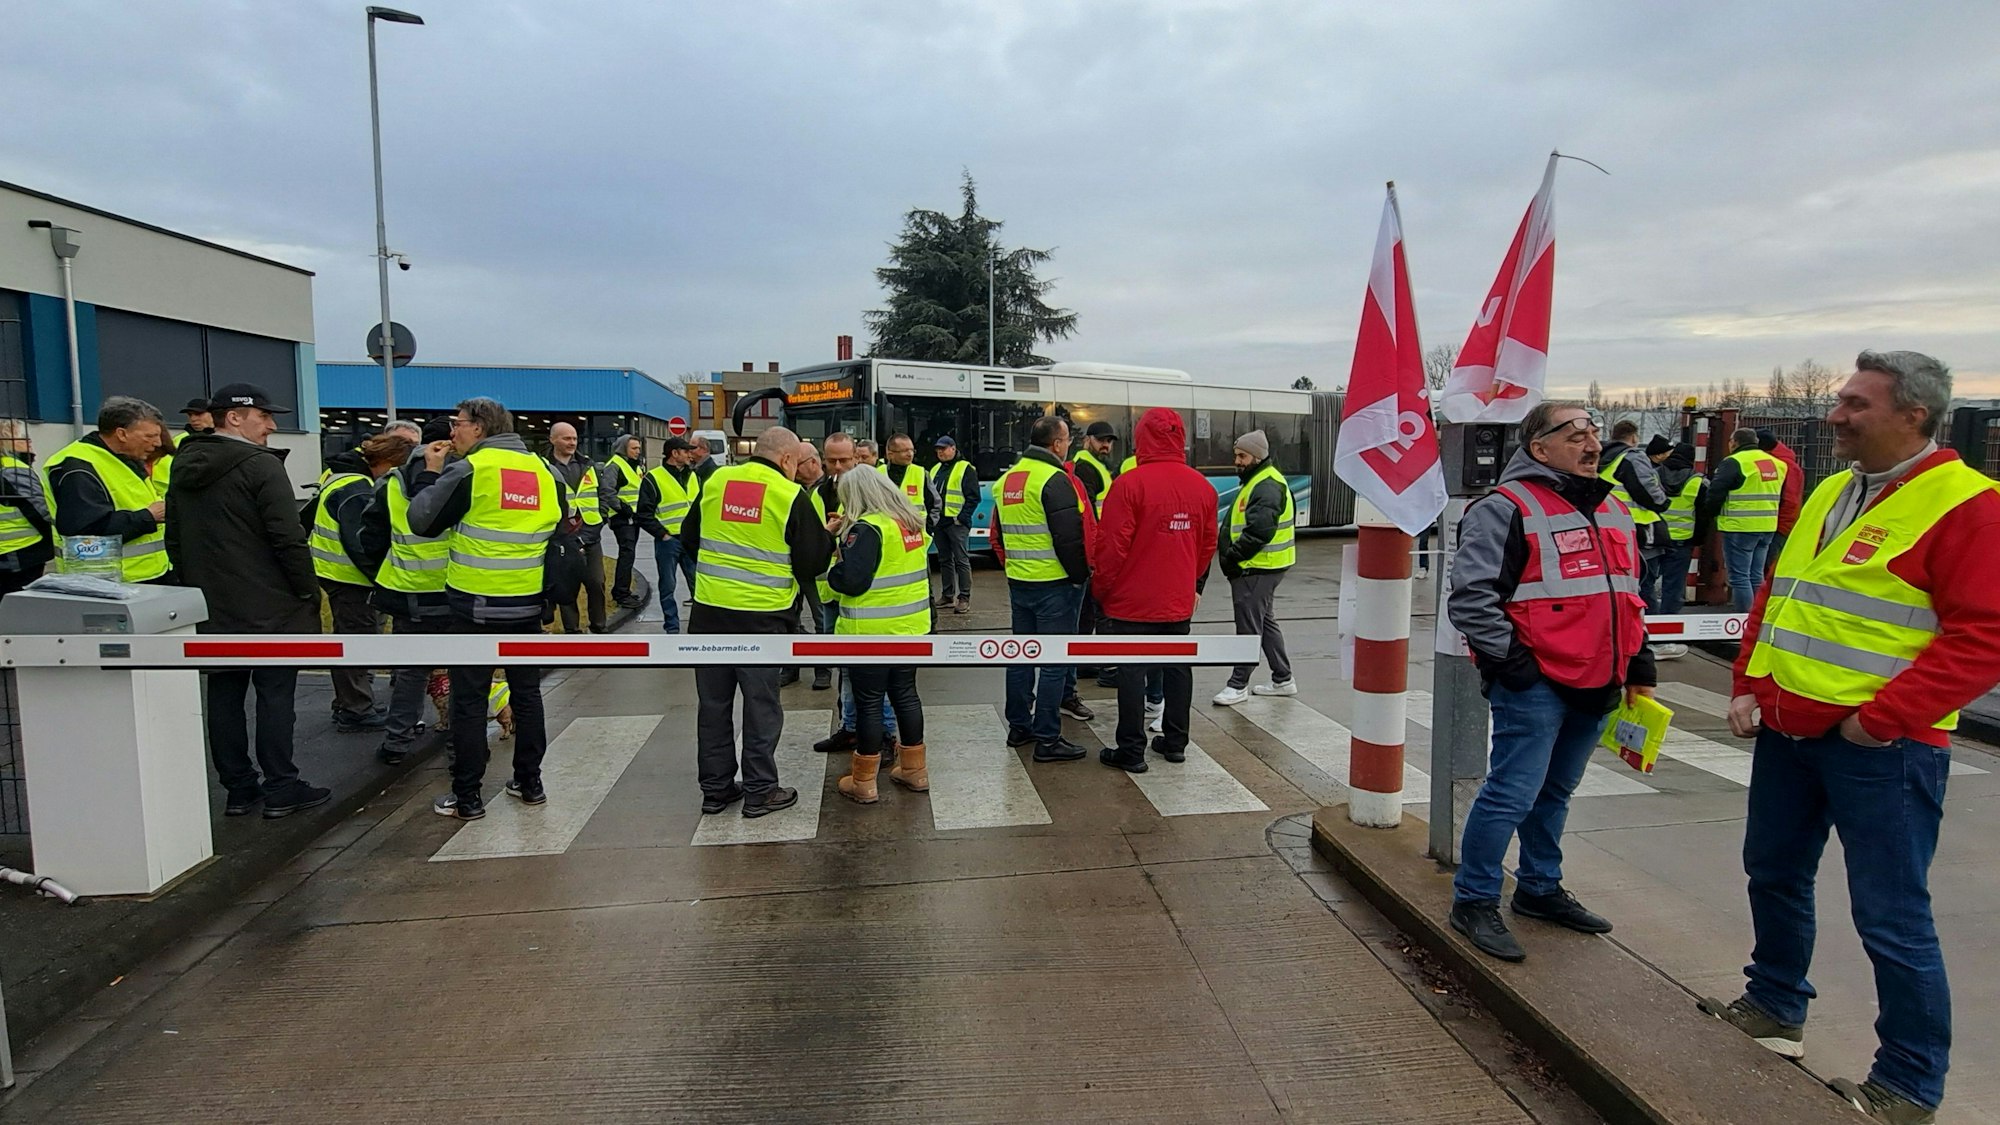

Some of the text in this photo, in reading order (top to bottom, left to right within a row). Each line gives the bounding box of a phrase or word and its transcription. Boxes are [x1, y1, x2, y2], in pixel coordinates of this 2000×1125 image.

[504, 492, 538, 506] ver.di
[1004, 490, 1023, 499] ver.di
[724, 503, 760, 519] ver.di
[678, 644, 761, 652] www.bebarmatic.de
